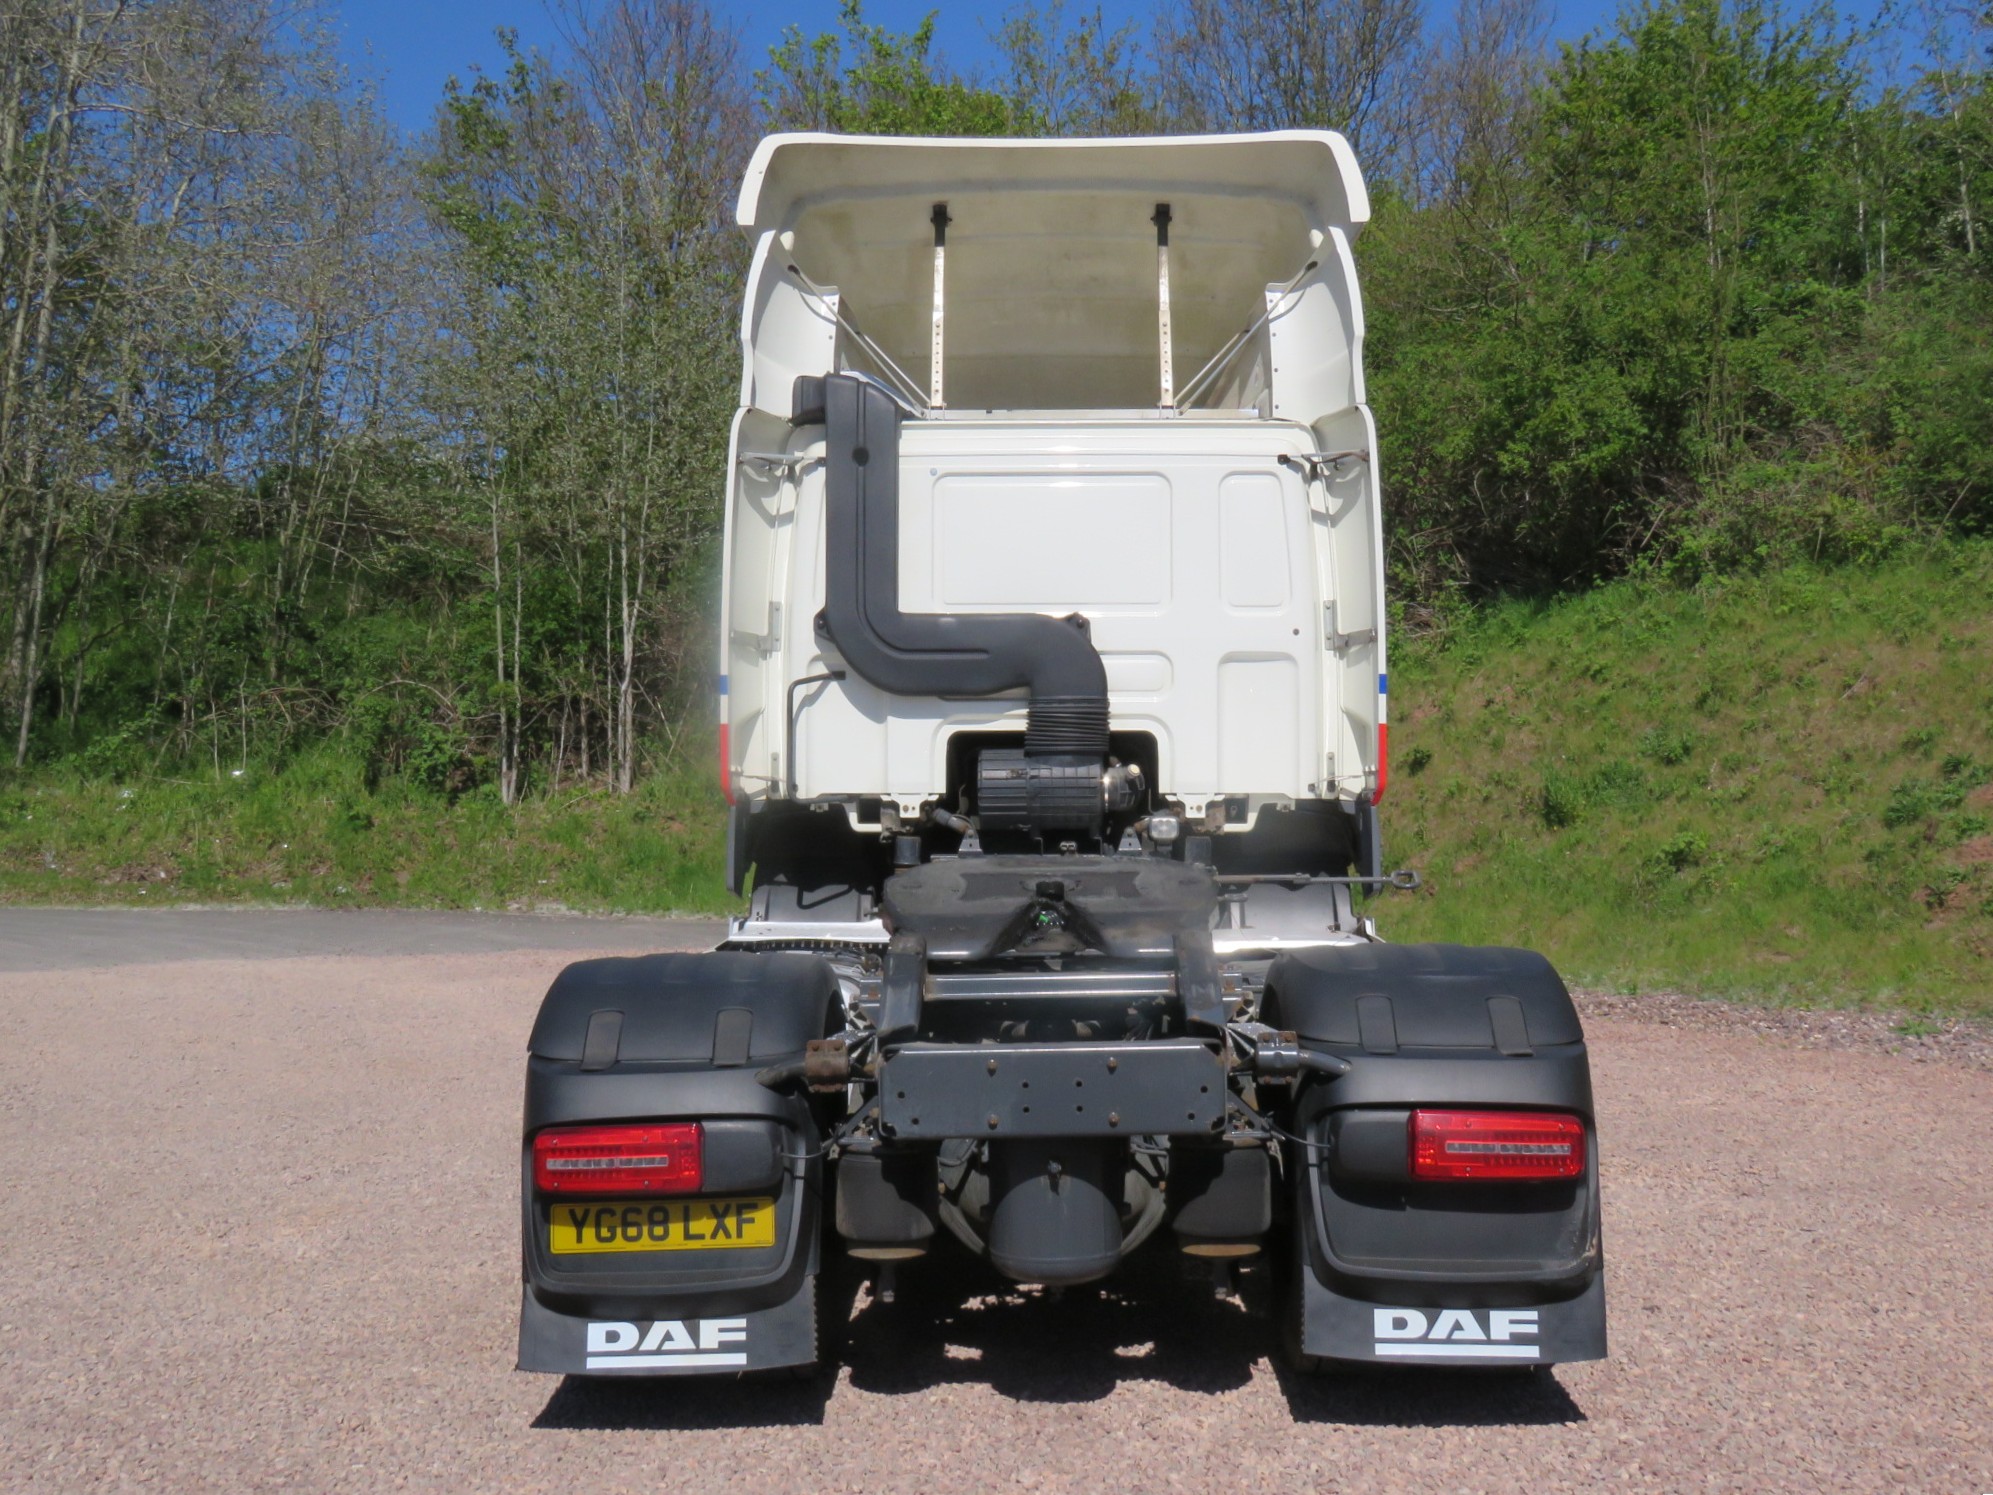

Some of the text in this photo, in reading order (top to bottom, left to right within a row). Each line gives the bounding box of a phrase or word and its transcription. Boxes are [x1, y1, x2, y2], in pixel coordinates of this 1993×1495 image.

[568, 1203, 759, 1244] YG68 LXF
[587, 1318, 747, 1352] DAF
[1374, 1308, 1539, 1340] DAF
